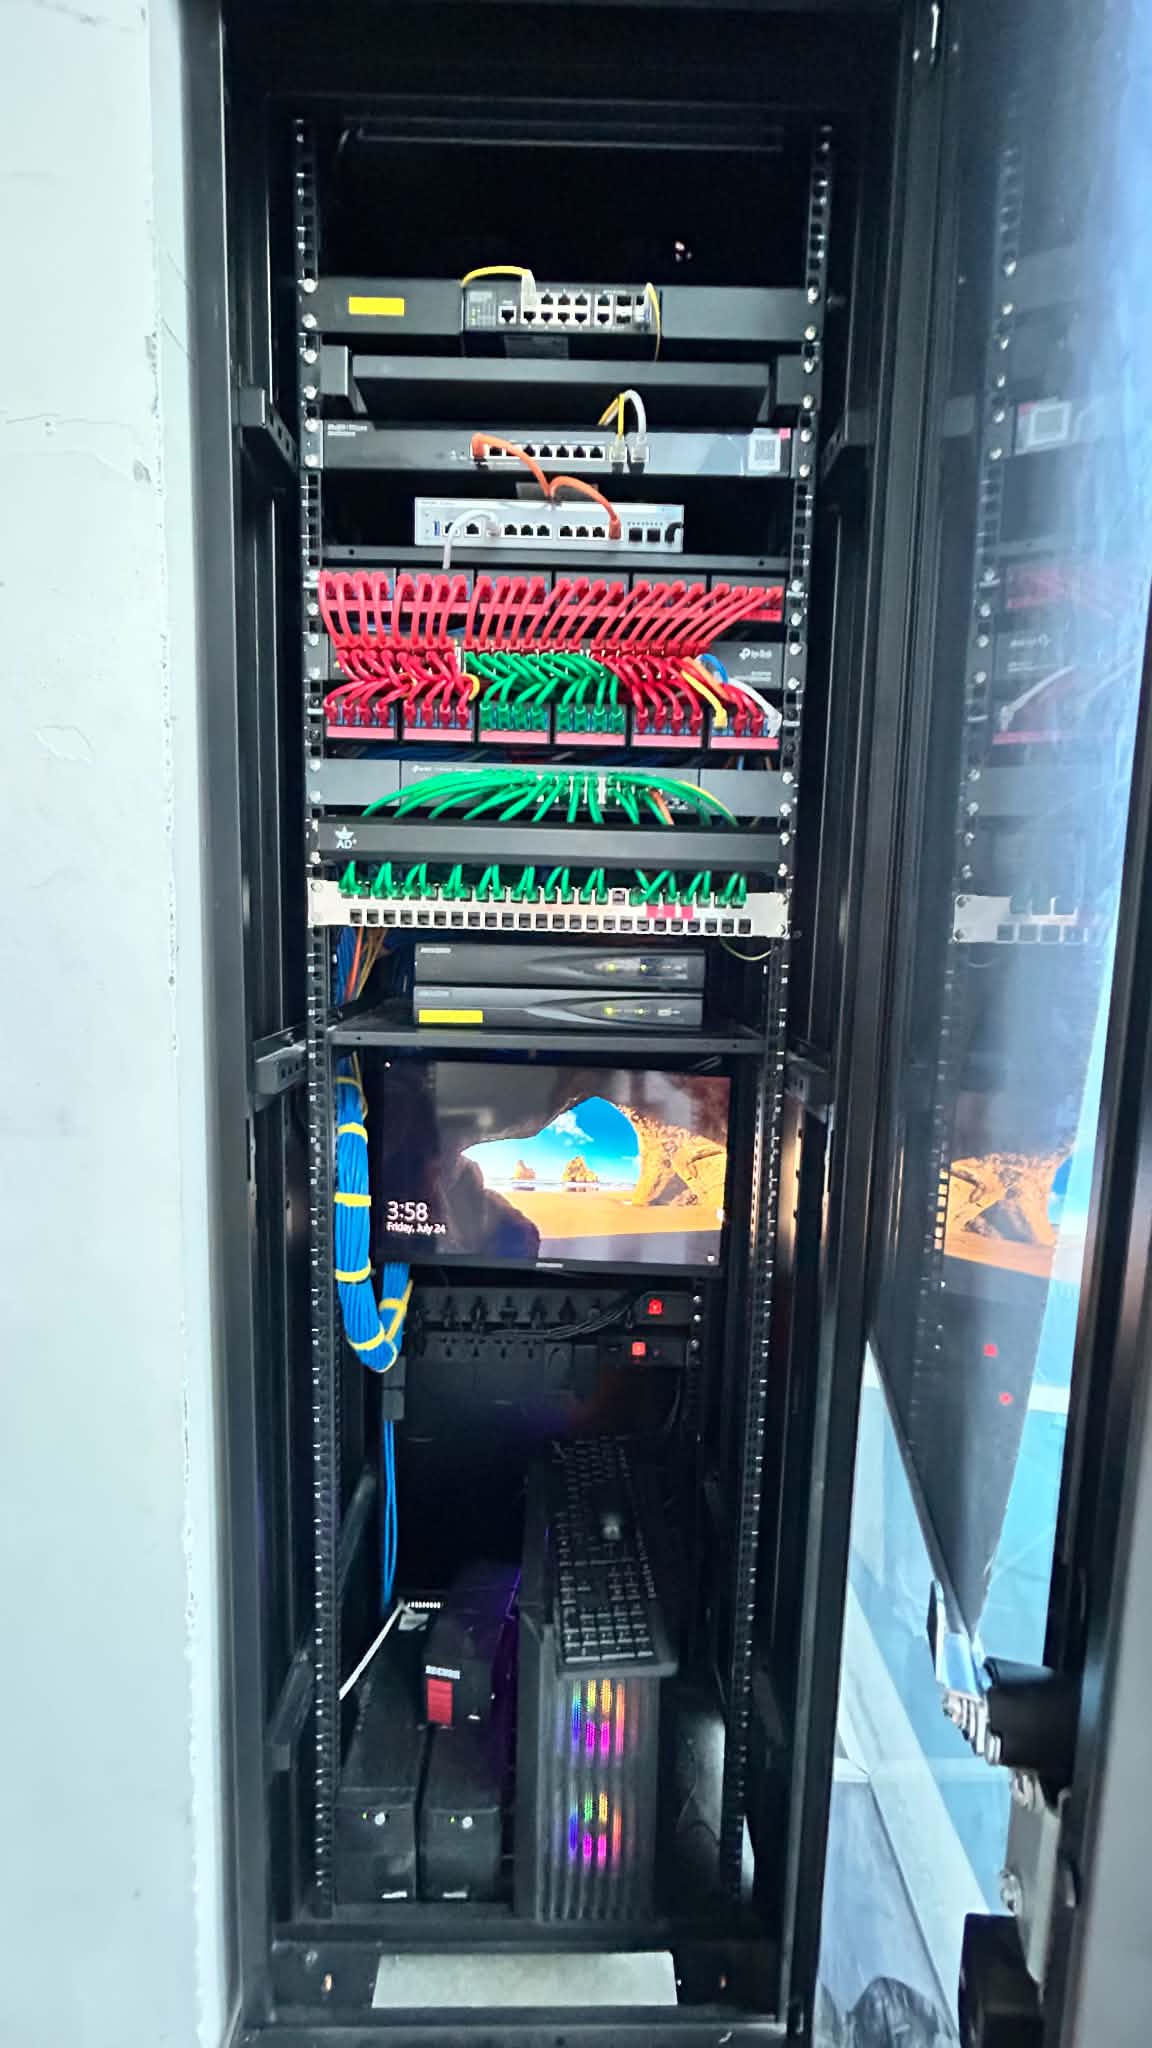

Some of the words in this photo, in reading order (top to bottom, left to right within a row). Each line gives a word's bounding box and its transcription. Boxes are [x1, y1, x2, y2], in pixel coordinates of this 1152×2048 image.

[387, 1201, 428, 1221] 3:58
[387, 1221, 415, 1235] Friday,
[416, 1223, 433, 1236] July
[433, 1224, 446, 1235] 24
